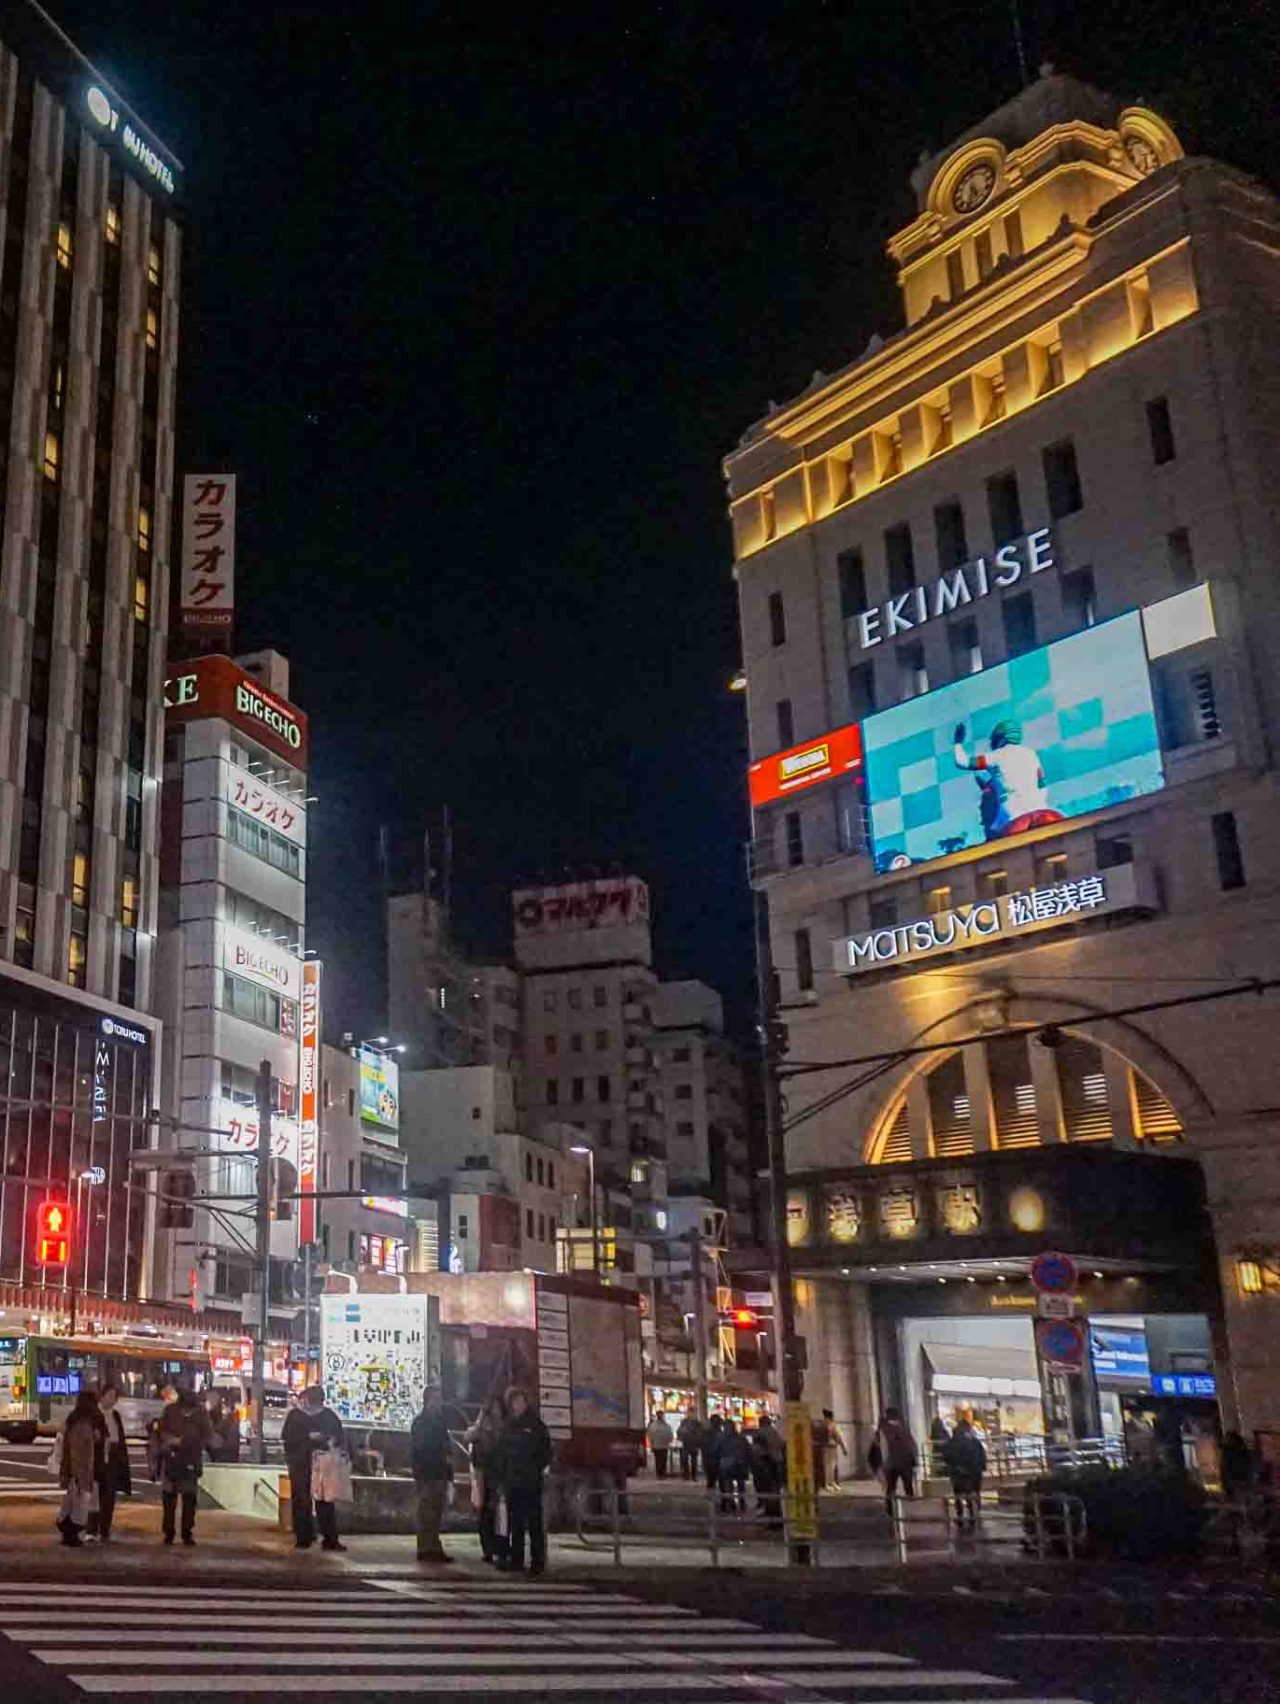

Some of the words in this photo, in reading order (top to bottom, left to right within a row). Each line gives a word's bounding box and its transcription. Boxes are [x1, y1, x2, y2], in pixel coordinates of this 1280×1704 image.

[110, 109, 140, 157] TBU
[193, 479, 226, 606] カラオケ
[859, 527, 1054, 650] EKIMISE
[236, 685, 263, 718] BIG
[264, 706, 300, 748] ECHO
[1007, 876, 1106, 927] 松屋浅草
[128, 1030, 147, 1044] HOTEL
[228, 1118, 290, 1156] カラケ
